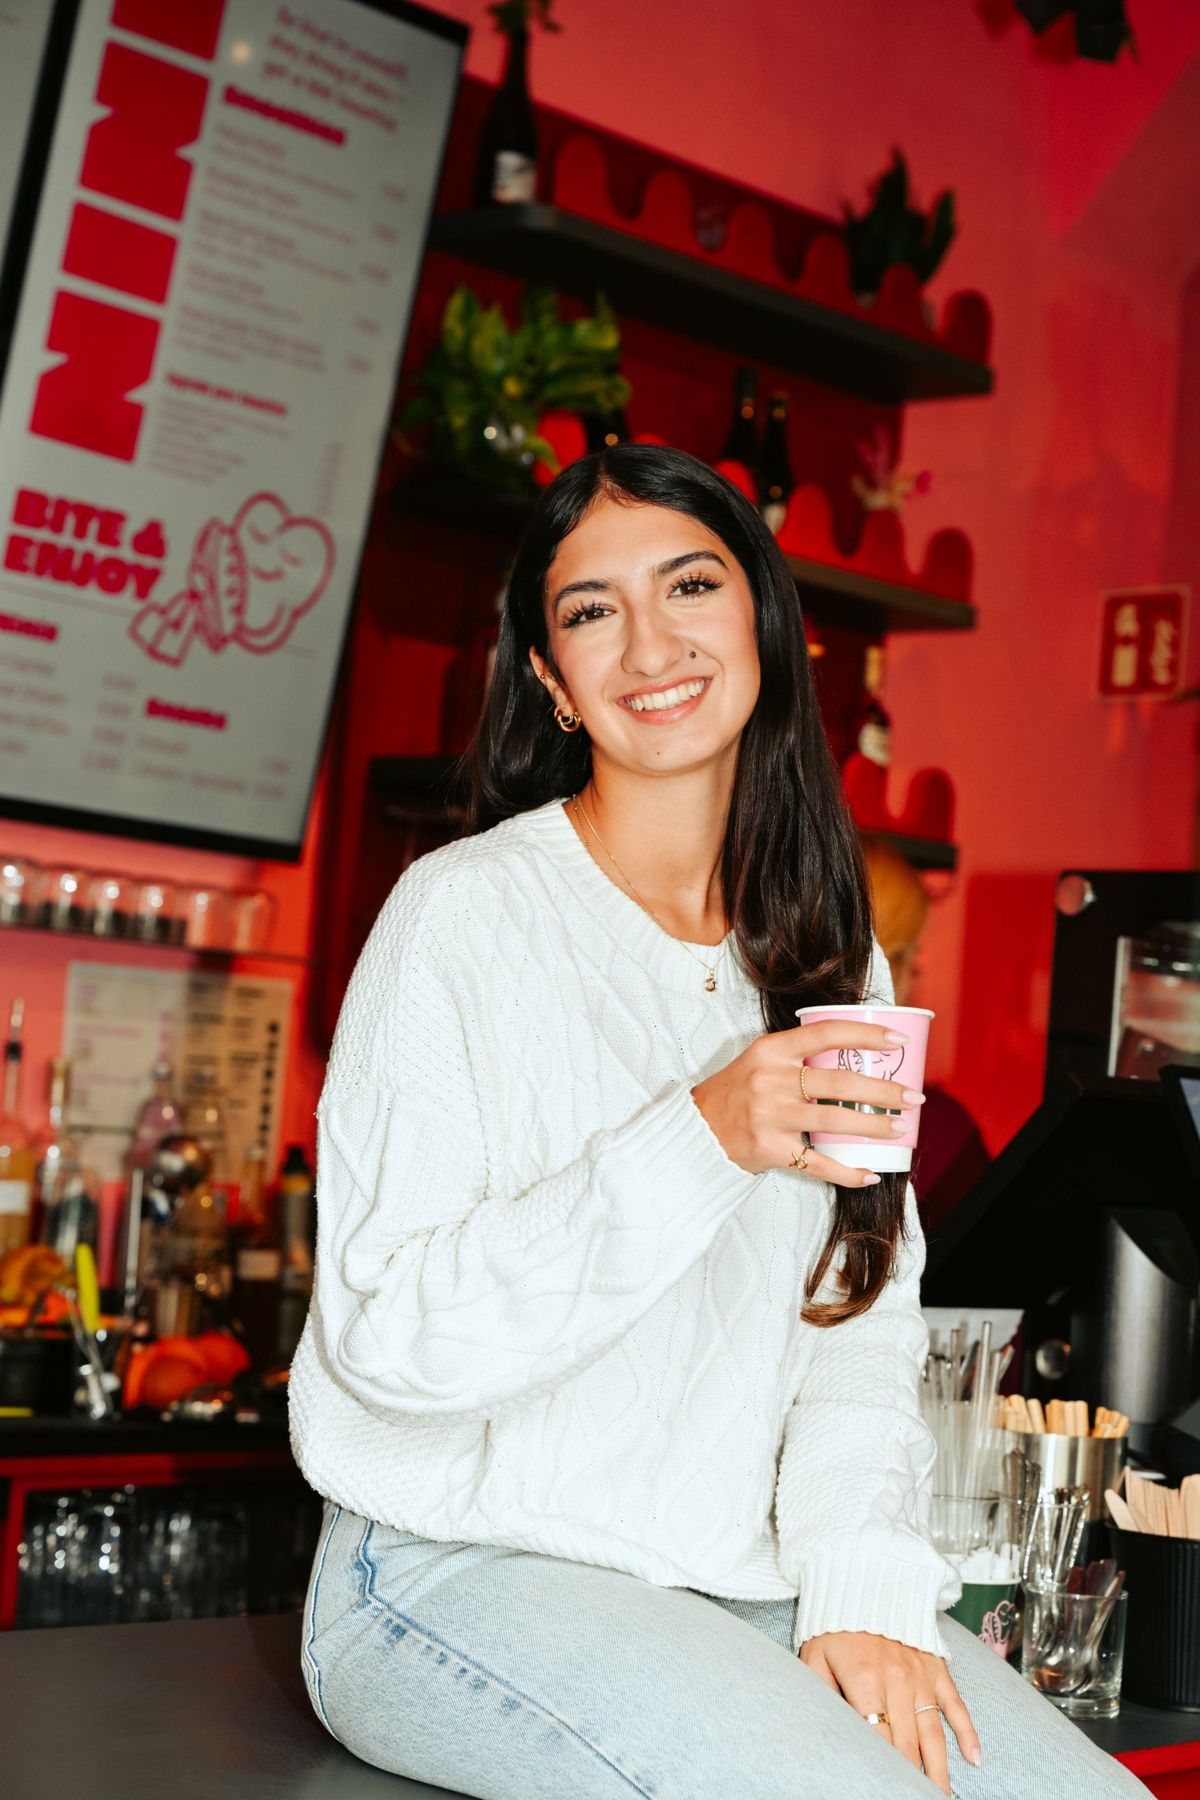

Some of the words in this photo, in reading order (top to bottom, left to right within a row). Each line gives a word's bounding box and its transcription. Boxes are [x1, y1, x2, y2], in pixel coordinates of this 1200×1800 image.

[13, 489, 126, 548] BITE
[132, 519, 166, 559] &
[4, 534, 161, 601] ENJOY
